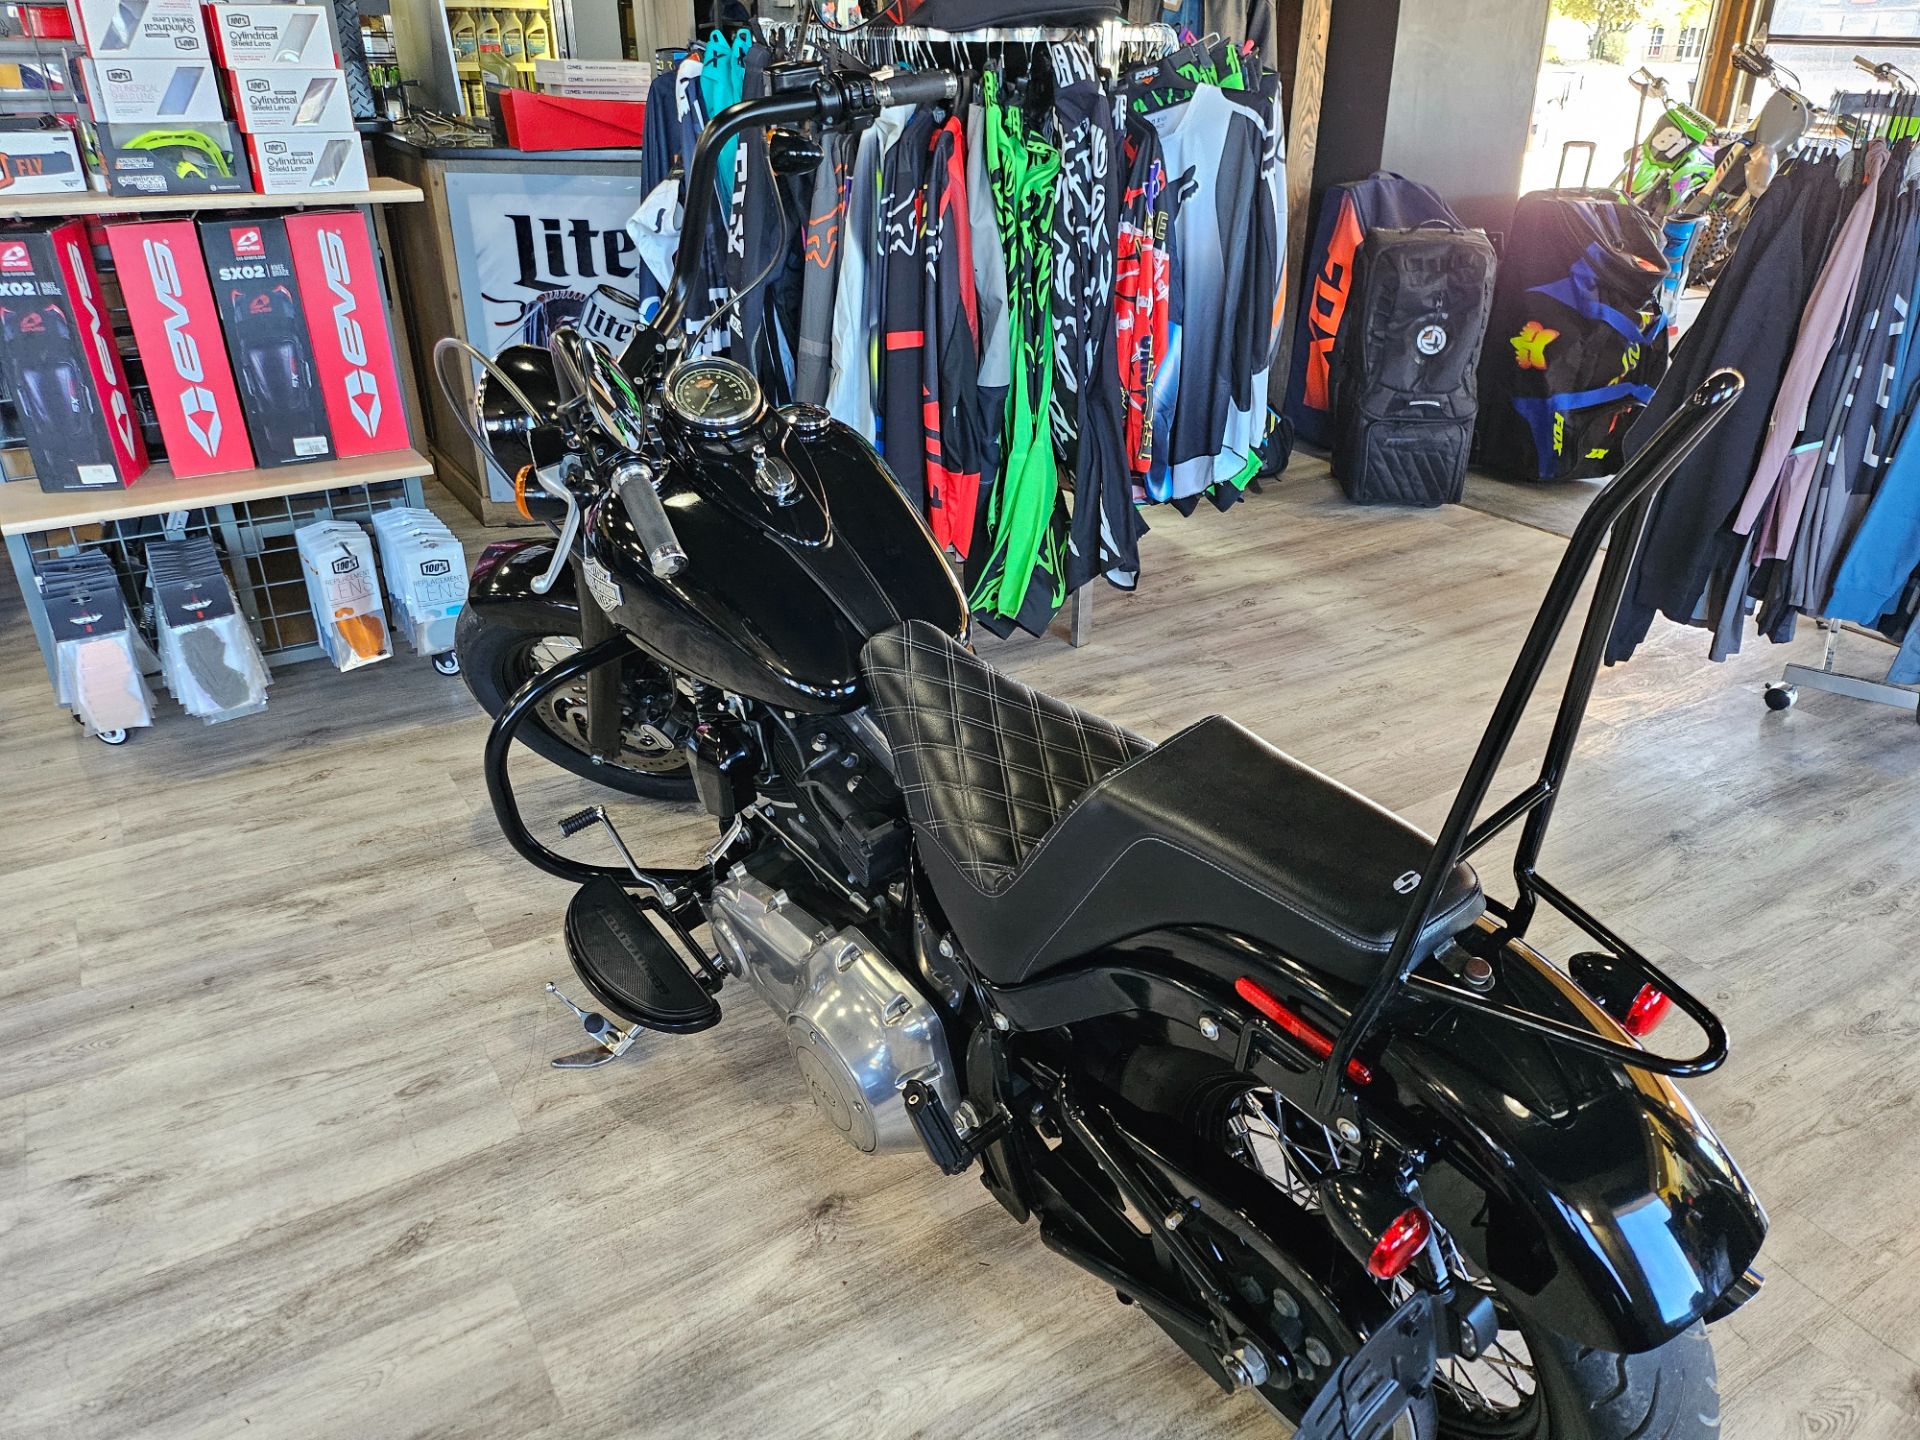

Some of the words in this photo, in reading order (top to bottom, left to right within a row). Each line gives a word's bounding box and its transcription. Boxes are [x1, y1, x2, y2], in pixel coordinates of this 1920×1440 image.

[144, 23, 196, 34] Cylindrical
[229, 31, 279, 42] Cylindrical
[249, 95, 298, 106] Cylindrical
[251, 104, 273, 112] Shield
[16, 157, 43, 176] FLY
[267, 156, 315, 167] Cylindrical
[504, 214, 637, 290] Lite
[219, 265, 266, 281] SX02
[584, 301, 633, 343] Lite
[1553, 411, 1565, 456] FOX
[335, 559, 356, 572] 100%
[424, 562, 447, 573] 100%
[325, 569, 370, 585] REPLACEMENT
[413, 574, 464, 587] REPLACEMENT
[326, 576, 374, 602] LENS
[414, 581, 465, 603] LENS
